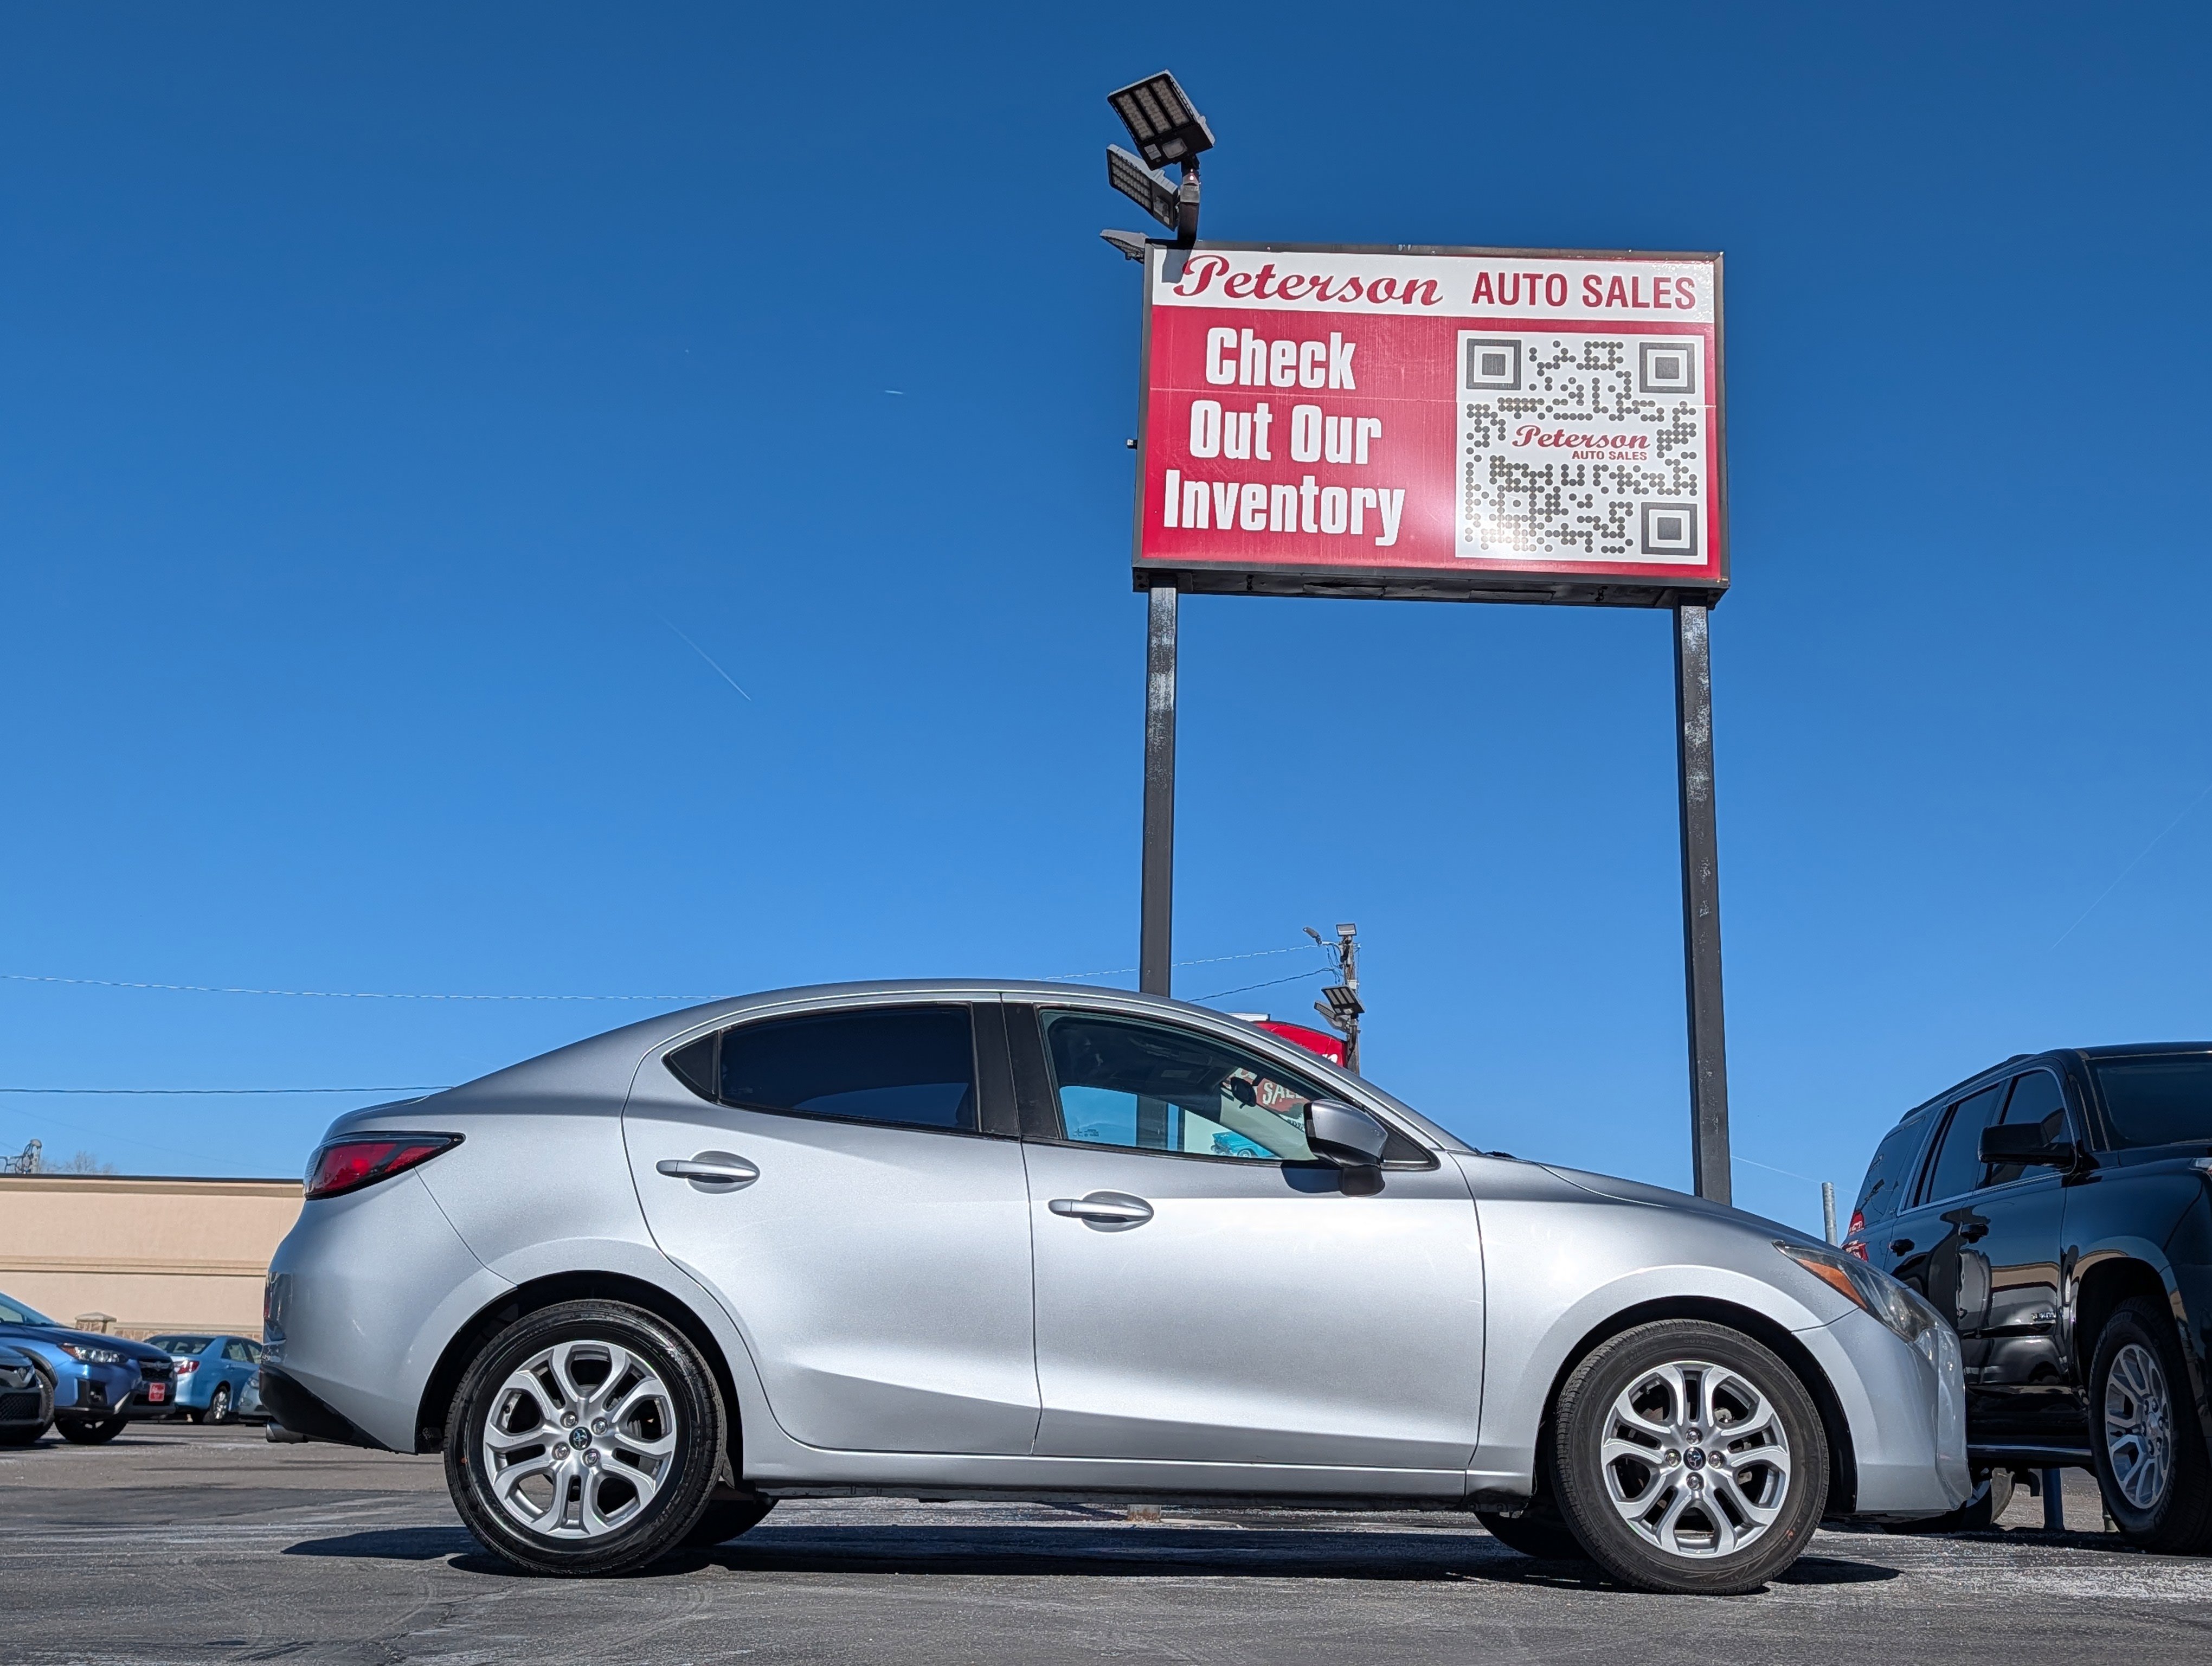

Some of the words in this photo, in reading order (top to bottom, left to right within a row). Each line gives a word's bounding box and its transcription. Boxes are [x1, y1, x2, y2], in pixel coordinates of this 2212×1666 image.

[1173, 254, 1443, 306] Peterson
[1471, 272, 1568, 306] AUTO
[1583, 274, 1695, 309] SALES
[1206, 327, 1356, 390] Check
[1189, 400, 1273, 460] Out
[1290, 404, 1382, 465] Our
[1512, 425, 1651, 449] Peterson
[1572, 450, 1605, 460] AUTO
[1609, 451, 1648, 460] SALES
[1164, 469, 1406, 547] Inventory
